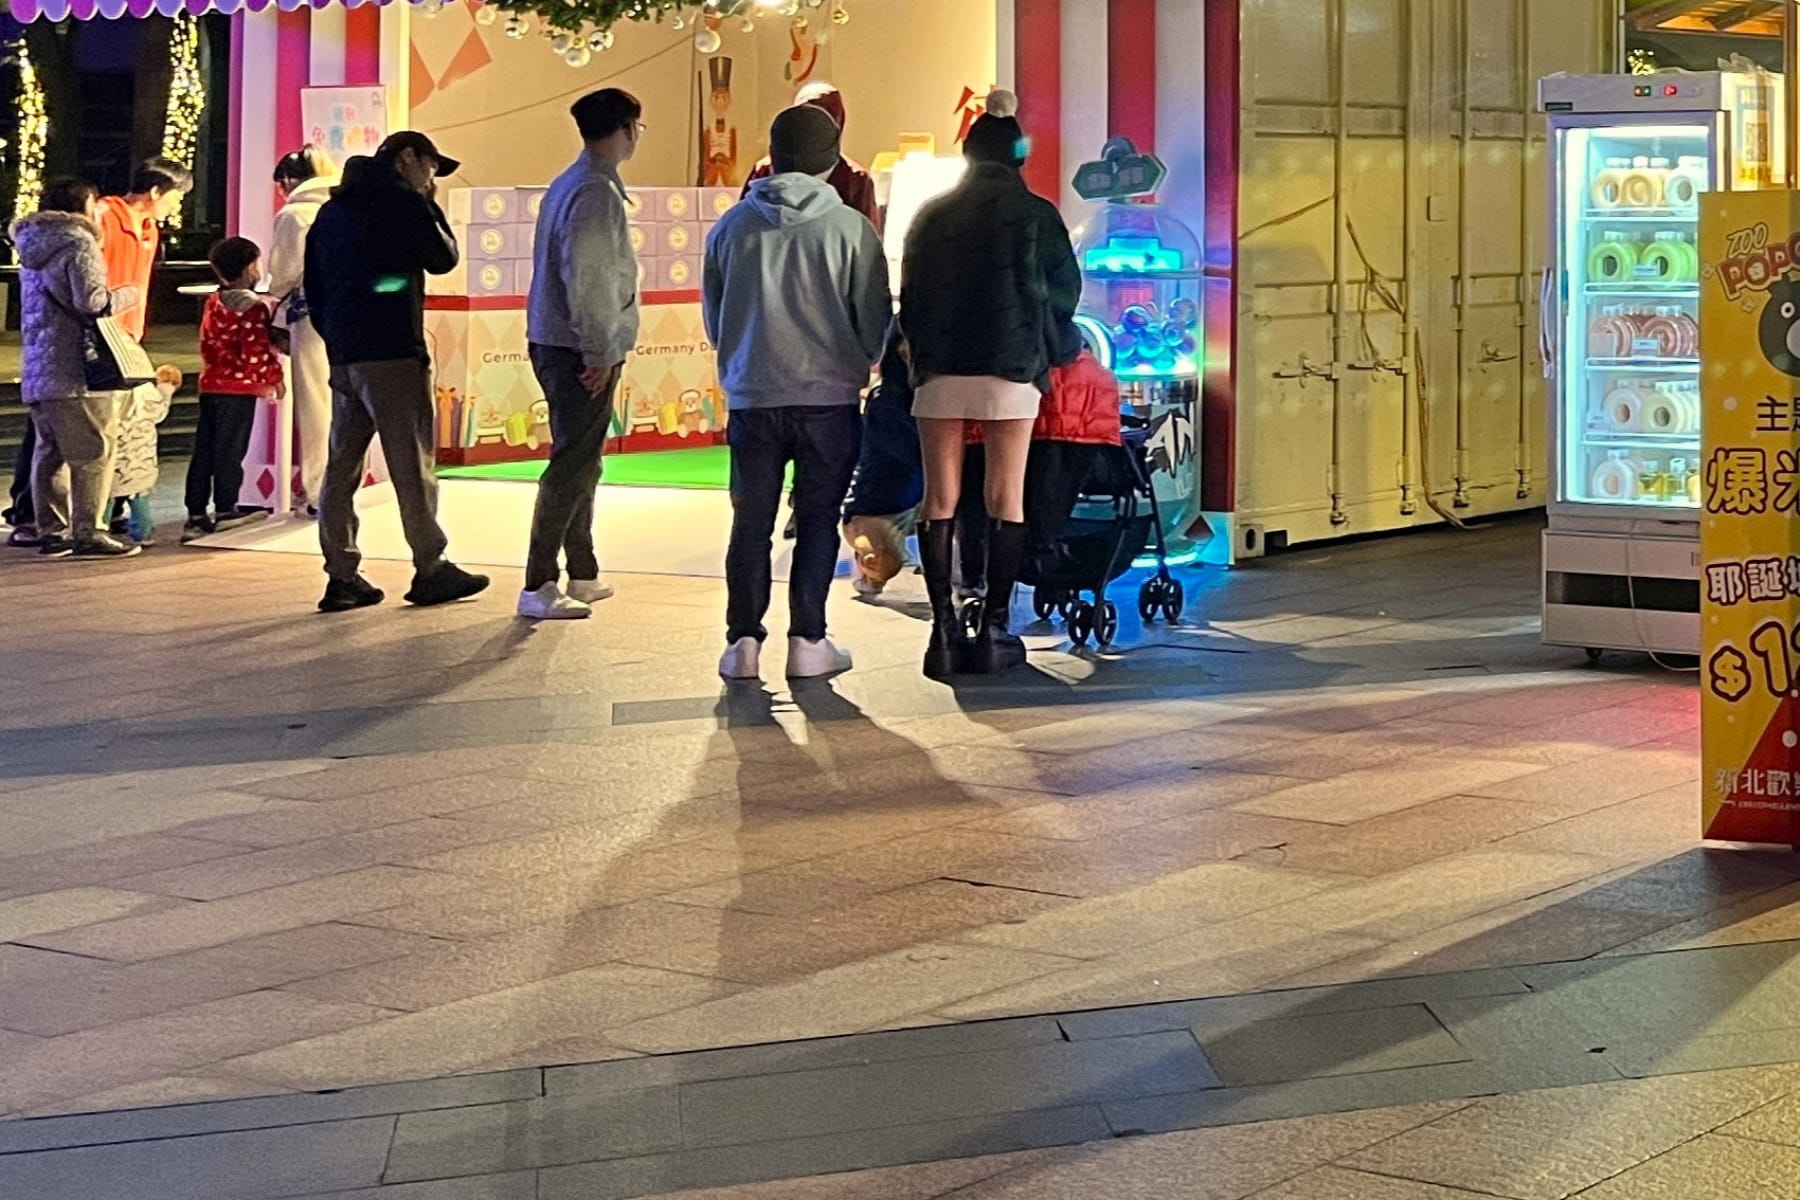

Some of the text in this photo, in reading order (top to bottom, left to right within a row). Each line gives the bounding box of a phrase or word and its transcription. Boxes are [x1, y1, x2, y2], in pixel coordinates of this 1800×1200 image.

[1726, 221, 1769, 260] ZOO
[636, 344, 695, 356] Germany
[482, 351, 530, 363] Germa
